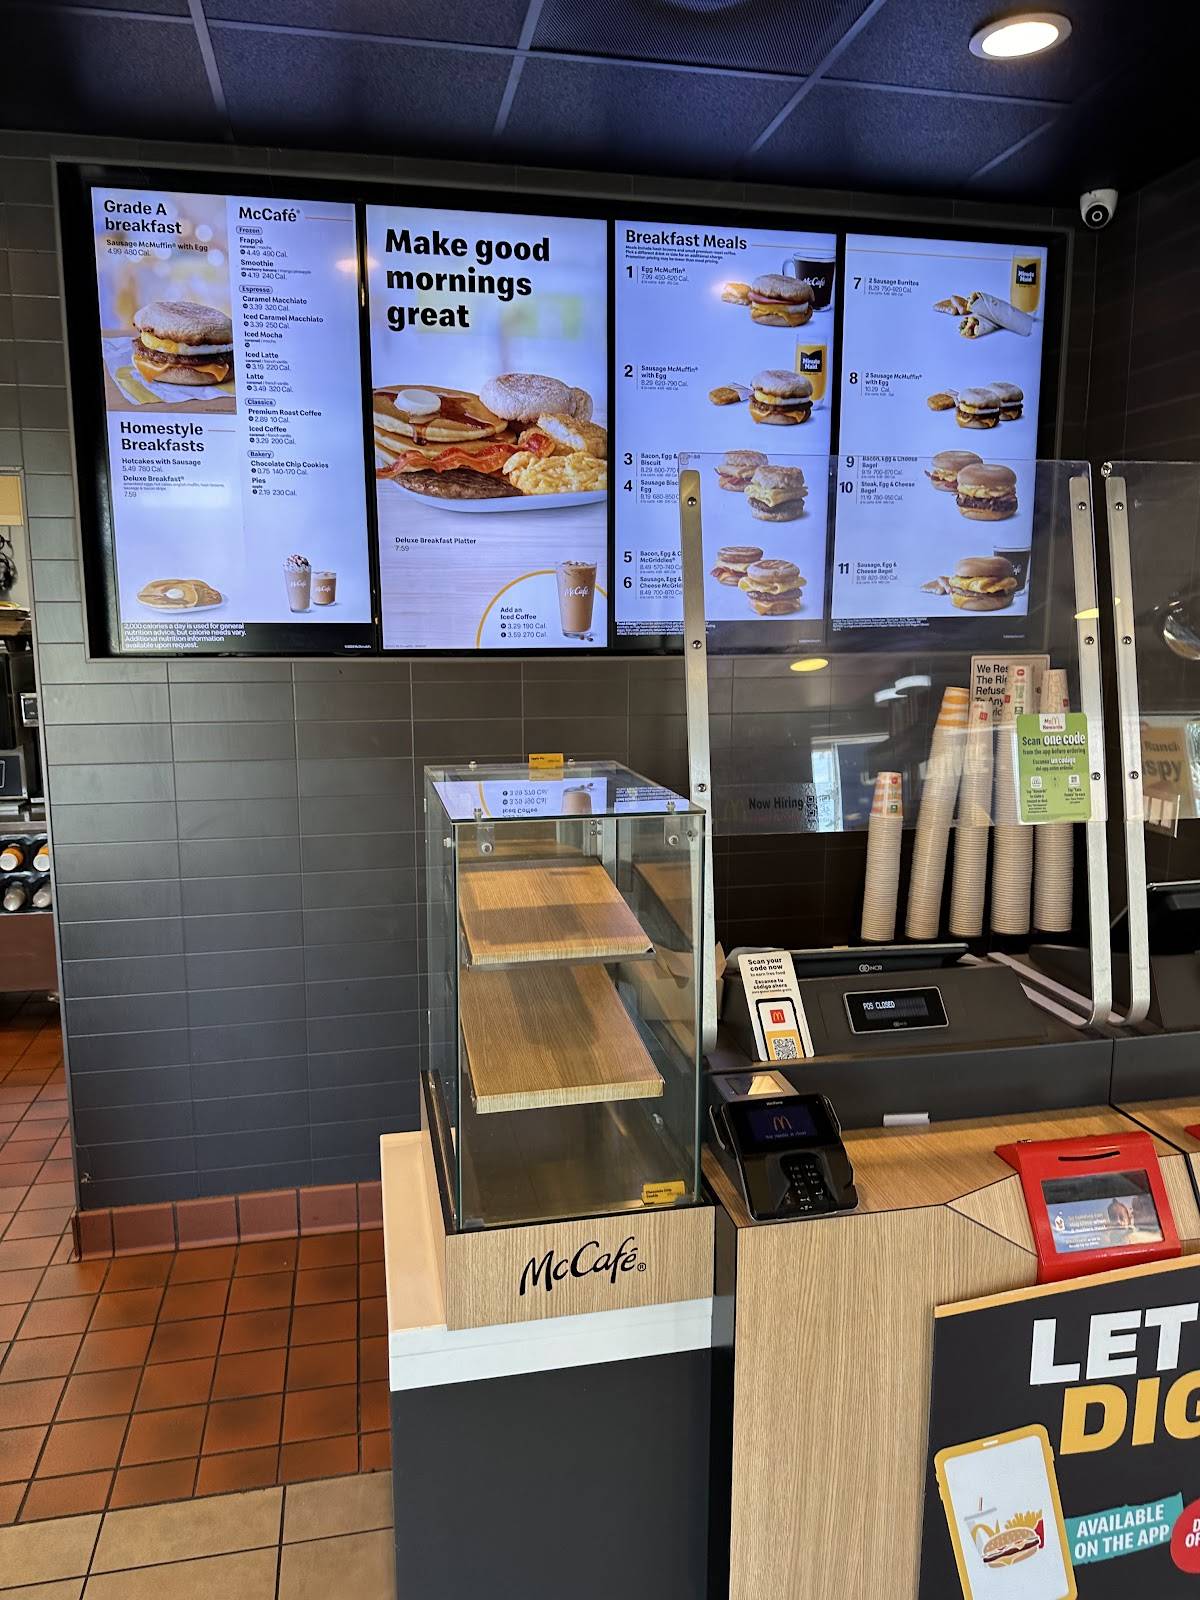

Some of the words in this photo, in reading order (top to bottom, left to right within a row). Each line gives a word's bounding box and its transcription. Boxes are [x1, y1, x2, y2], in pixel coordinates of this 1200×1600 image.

[104, 200, 152, 215] Grade
[156, 203, 167, 216] A
[105, 217, 182, 234] breakfast
[106, 239, 138, 248] Sausage
[195, 244, 208, 252] Egg
[240, 237, 264, 245] Frappé
[626, 229, 700, 247] Breakfast
[704, 235, 747, 250] Meals
[386, 228, 468, 257] Make
[476, 237, 550, 265] good
[241, 259, 274, 267] Smoothie
[627, 266, 633, 278] 1
[642, 266, 653, 274] Egg
[386, 266, 532, 302] mornings
[854, 277, 862, 290] 7
[272, 297, 307, 305] Macchiato
[289, 315, 324, 323] Macchiato
[387, 304, 470, 332] great
[261, 331, 283, 339] Mocha
[624, 365, 633, 378] 2
[642, 365, 666, 373] Sausage
[850, 372, 858, 385] 8
[120, 421, 203, 438] Homestyle
[122, 438, 205, 452] Breakfasts
[172, 459, 201, 467] Sausage
[624, 453, 633, 465] 3
[846, 456, 855, 468] 9
[624, 480, 633, 492] 4
[840, 482, 853, 493] 10
[624, 551, 632, 563] 5
[838, 563, 850, 574] 11
[624, 577, 632, 588] 6
[977, 665, 990, 673] We
[977, 676, 993, 684] The
[1023, 737, 1040, 746] Scan
[1044, 735, 1063, 746] one
[1063, 732, 1086, 746] code
[749, 799, 771, 810] Now
[774, 797, 804, 810] Hiring
[875, 1001, 895, 1009] CLOSED
[1030, 1302, 1199, 1386] LET
[1059, 1369, 1200, 1455] DIG
[1077, 1504, 1165, 1538] AVAILABLE
[1075, 1540, 1098, 1559] ON
[1103, 1532, 1134, 1554] THE
[1137, 1524, 1170, 1546] APP
